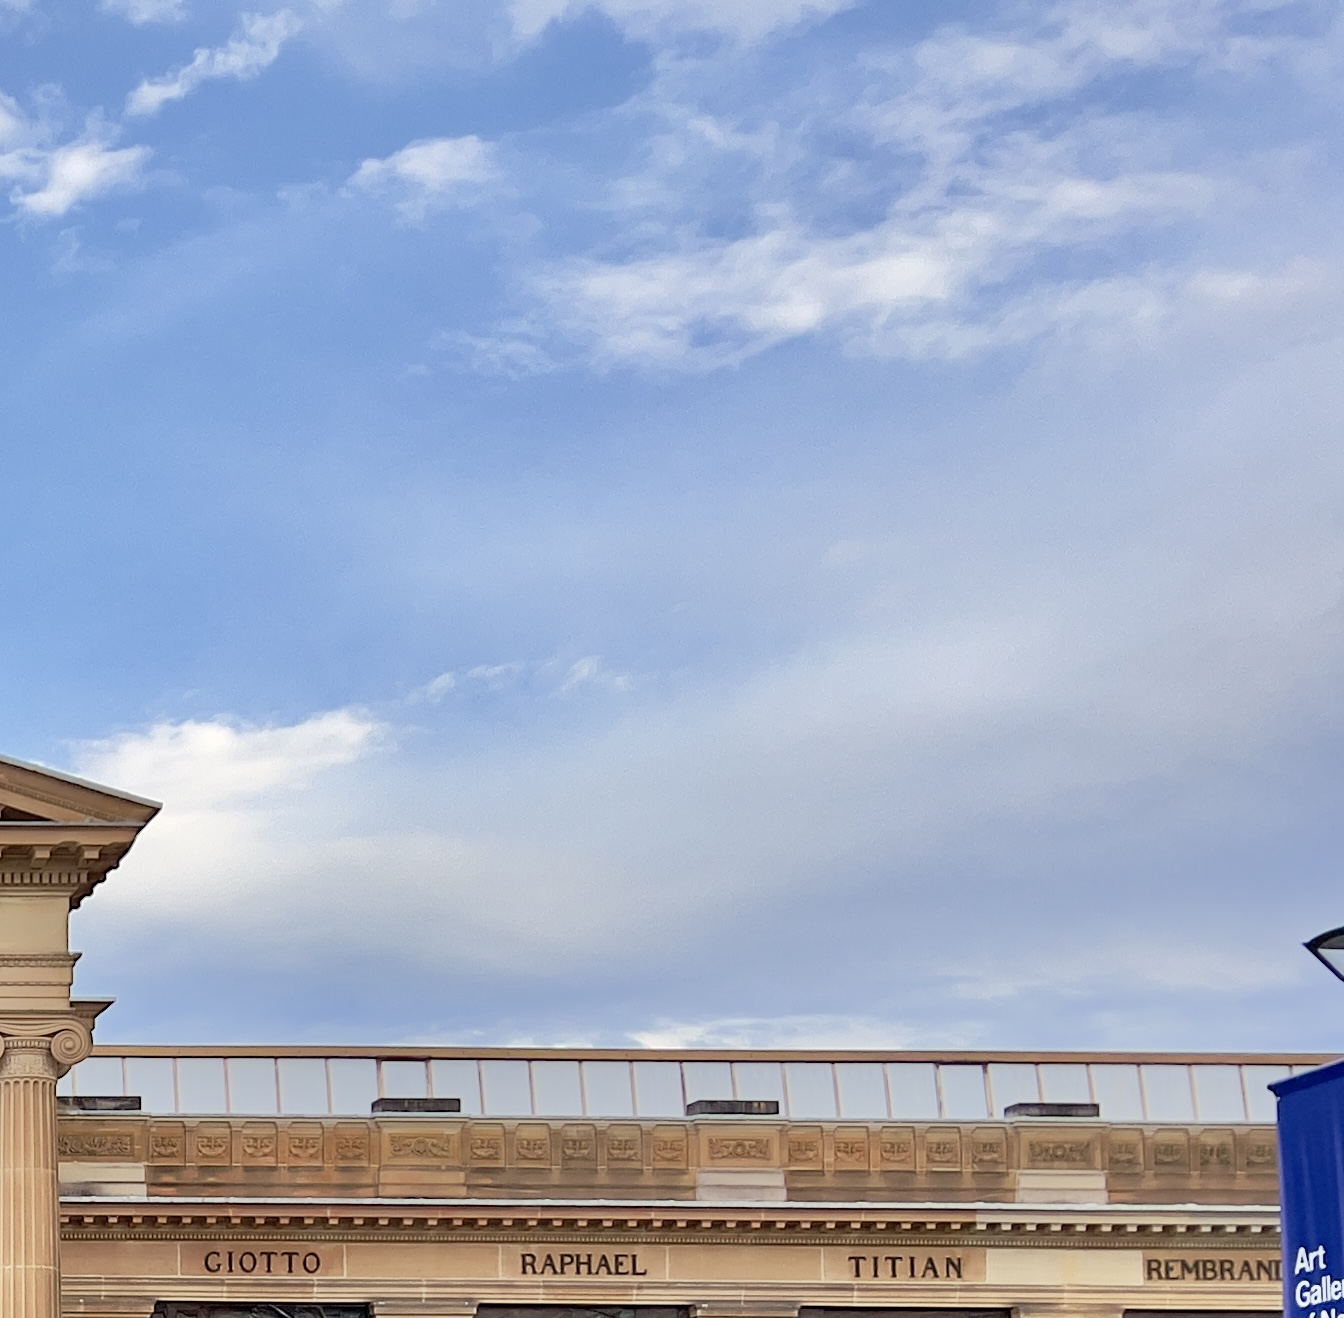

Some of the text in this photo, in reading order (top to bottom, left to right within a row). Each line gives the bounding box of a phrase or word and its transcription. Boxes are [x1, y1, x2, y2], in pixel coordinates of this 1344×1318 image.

[204, 1251, 321, 1274] GIOTTO
[520, 1253, 648, 1276] RAPHAEL
[848, 1256, 964, 1279] TITIAN
[1294, 1245, 1327, 1275] Art
